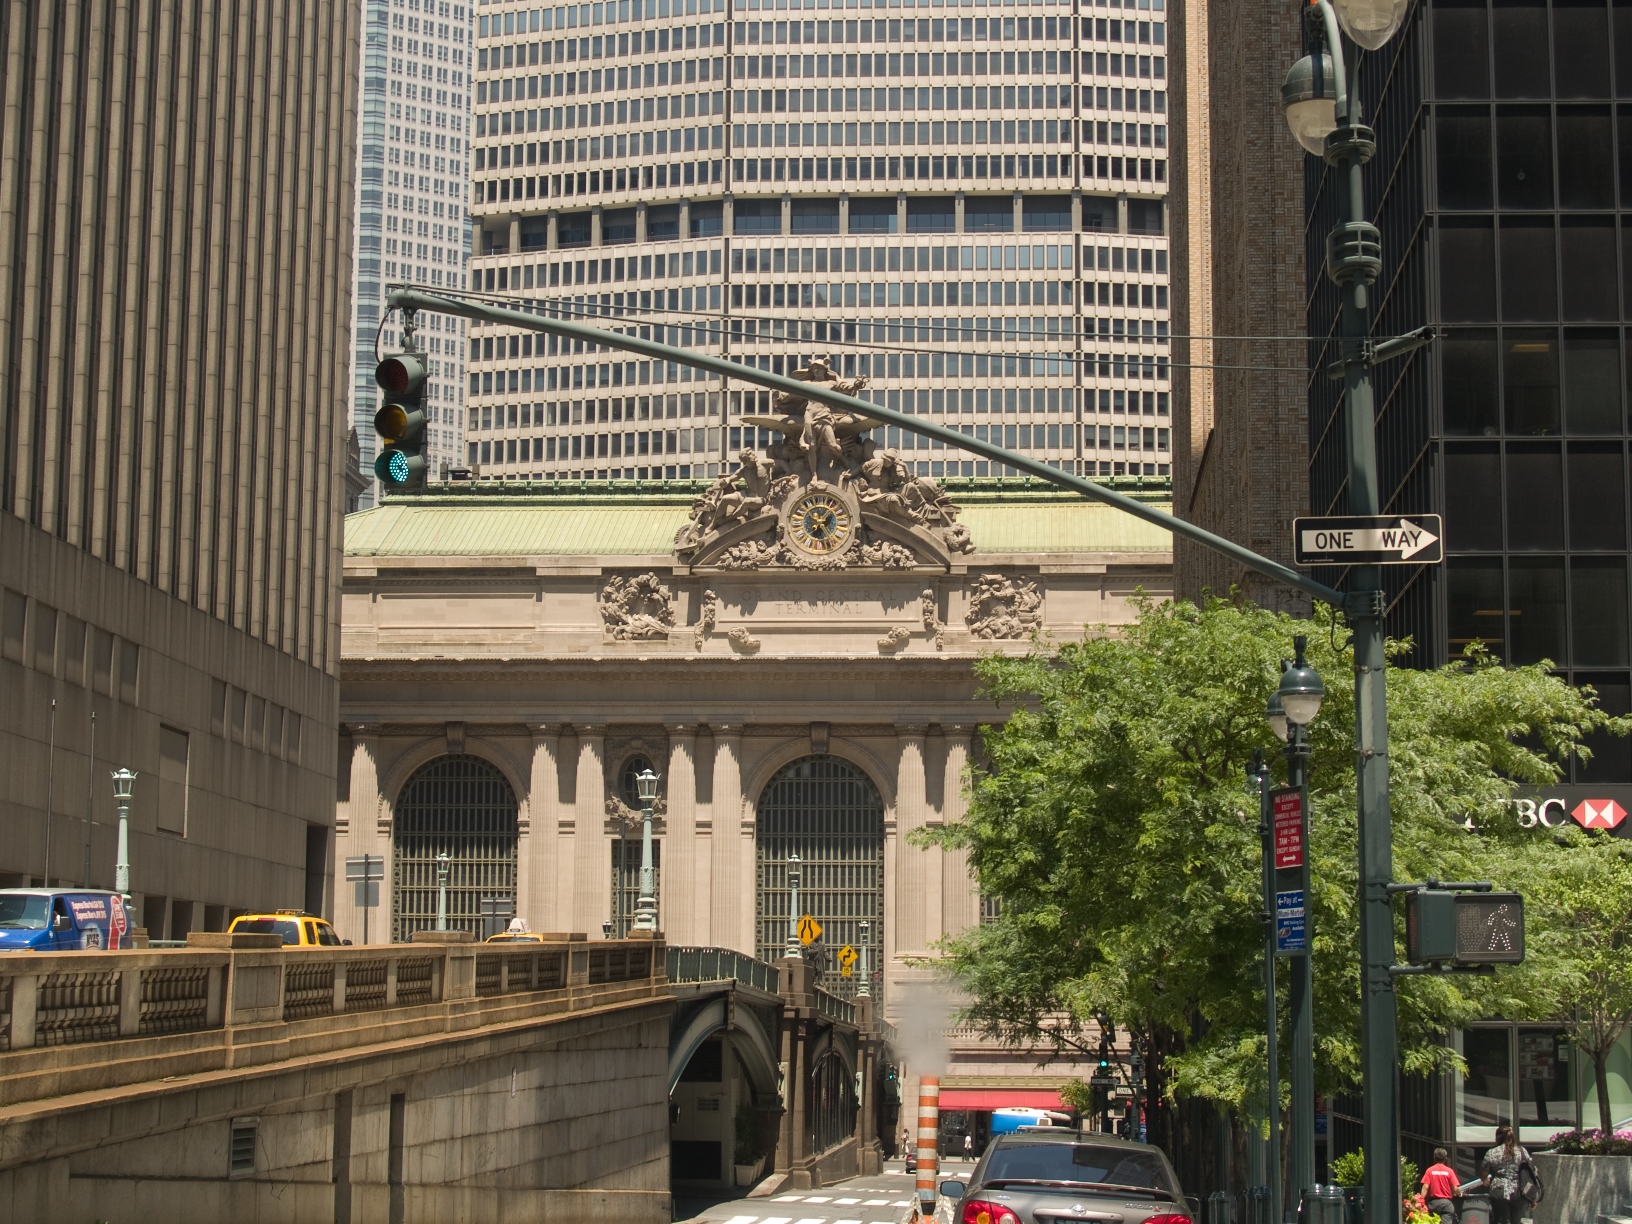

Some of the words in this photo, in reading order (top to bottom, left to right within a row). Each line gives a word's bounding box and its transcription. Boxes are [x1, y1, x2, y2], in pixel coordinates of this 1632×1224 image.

[1315, 532, 1354, 549] ONE
[1382, 530, 1423, 548] WAY
[741, 590, 802, 601] GRAND
[815, 590, 897, 601] CENTRAL
[775, 603, 863, 615] TERMINAL
[1275, 795, 1280, 803] NO
[1281, 792, 1300, 802] STANDING
[1281, 803, 1294, 811] EXCEPT
[1278, 837, 1288, 845] 7AM
[1290, 835, 1300, 844] 7PM
[1276, 846, 1288, 855] EXCEPT
[1283, 896, 1292, 906] Pay
[1292, 896, 1298, 904] at
